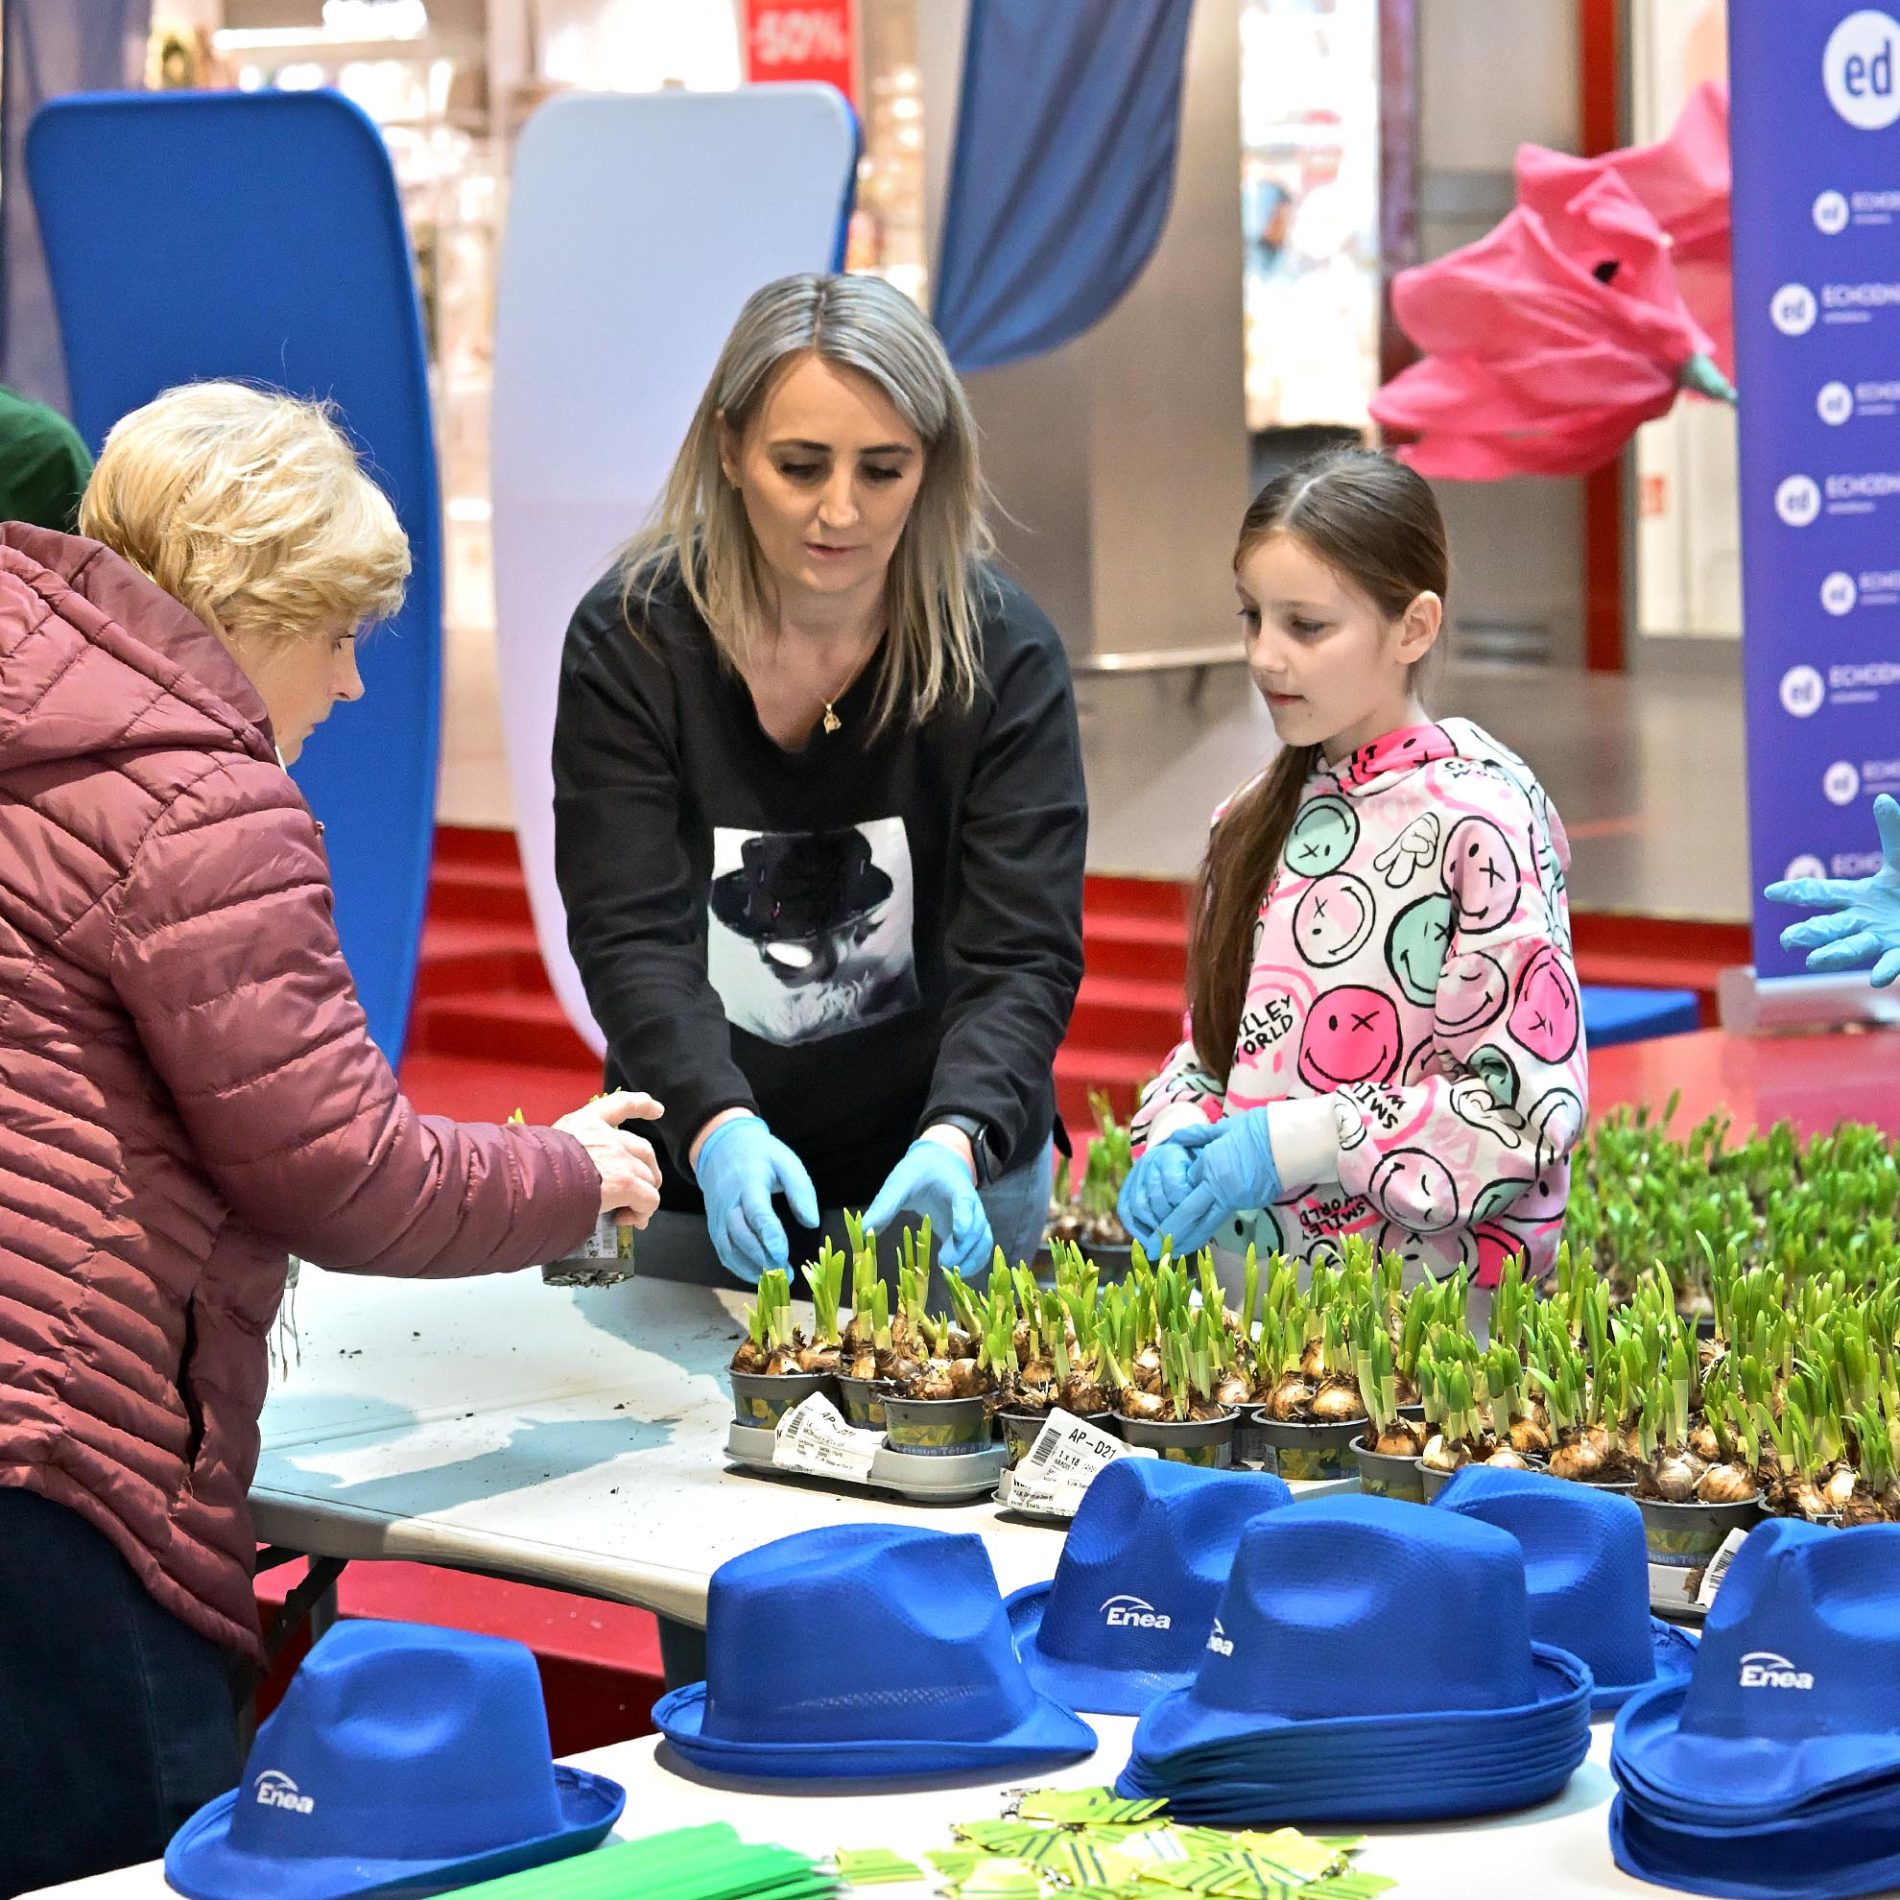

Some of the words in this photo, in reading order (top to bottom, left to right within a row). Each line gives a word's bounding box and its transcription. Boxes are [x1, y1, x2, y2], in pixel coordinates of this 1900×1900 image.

[1844, 36, 1892, 96] ed
[1239, 994, 1291, 1038] ILEY
[1106, 1607, 1171, 1630] Enea
[1740, 1665, 1814, 1690] Enea
[257, 1781, 315, 1815] Enea
